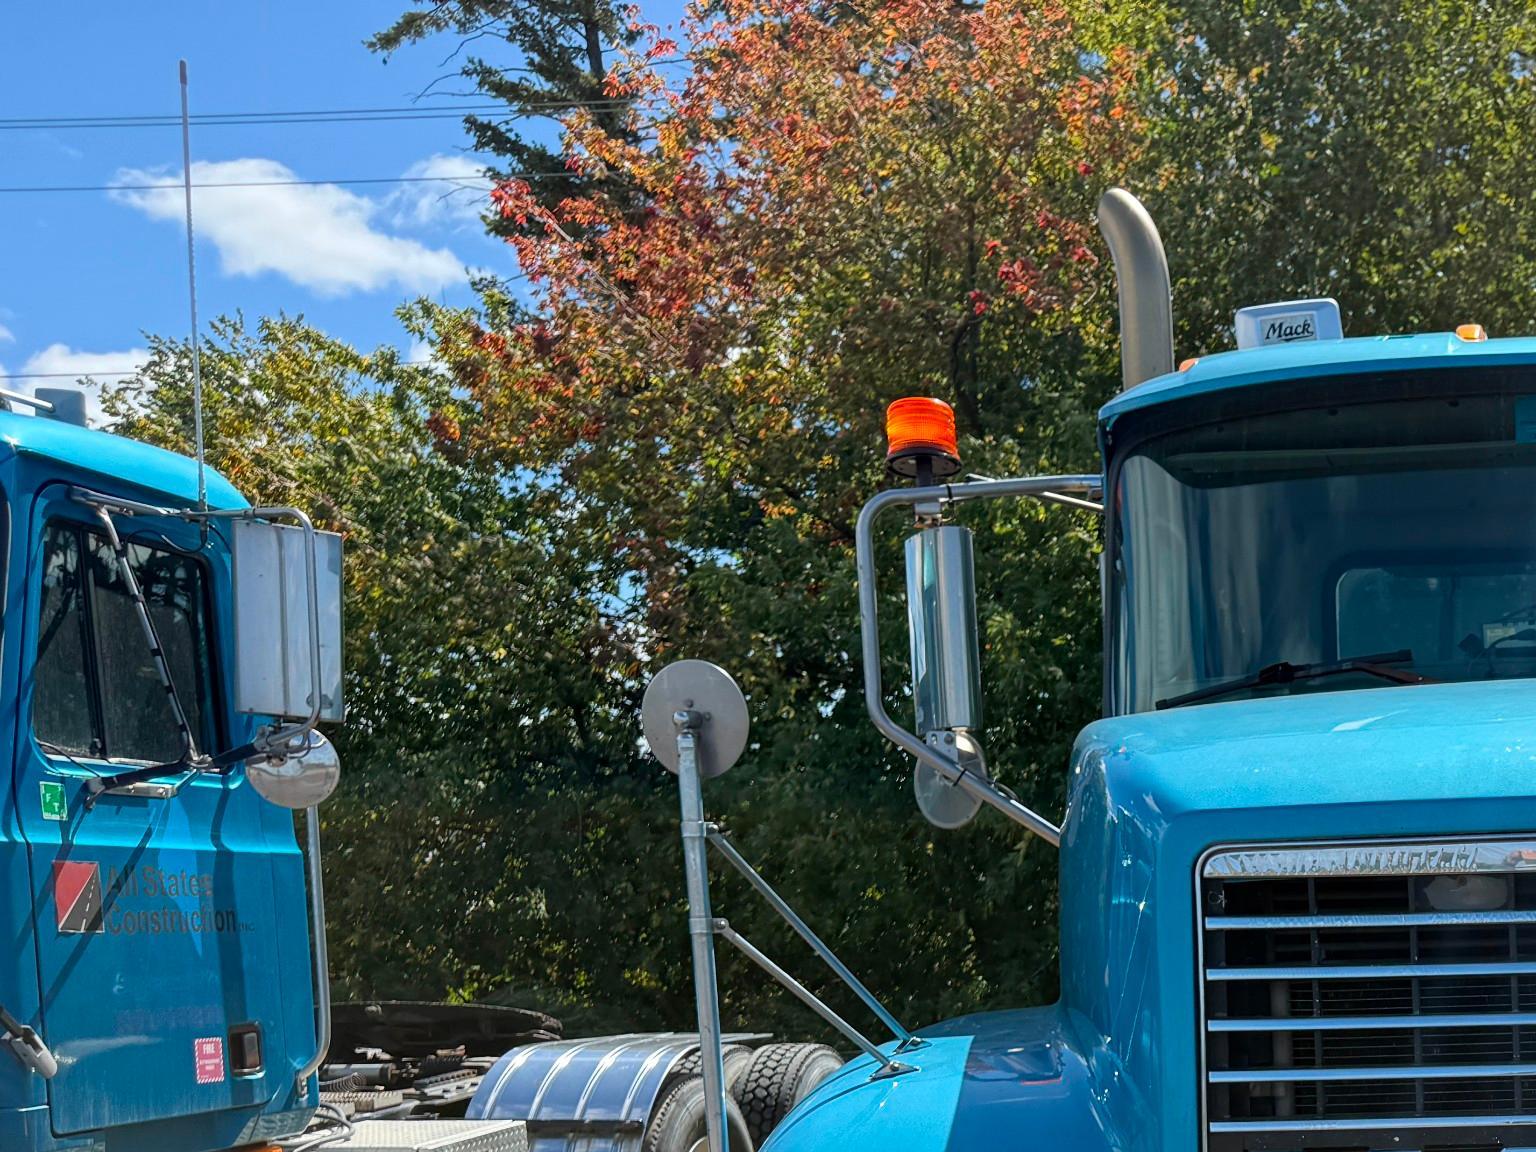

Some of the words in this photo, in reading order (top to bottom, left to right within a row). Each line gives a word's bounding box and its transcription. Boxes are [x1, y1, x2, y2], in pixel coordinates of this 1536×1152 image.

[1265, 319, 1314, 341] Mack
[107, 864, 138, 896] All
[143, 866, 213, 897] States
[107, 903, 237, 935] Construction
